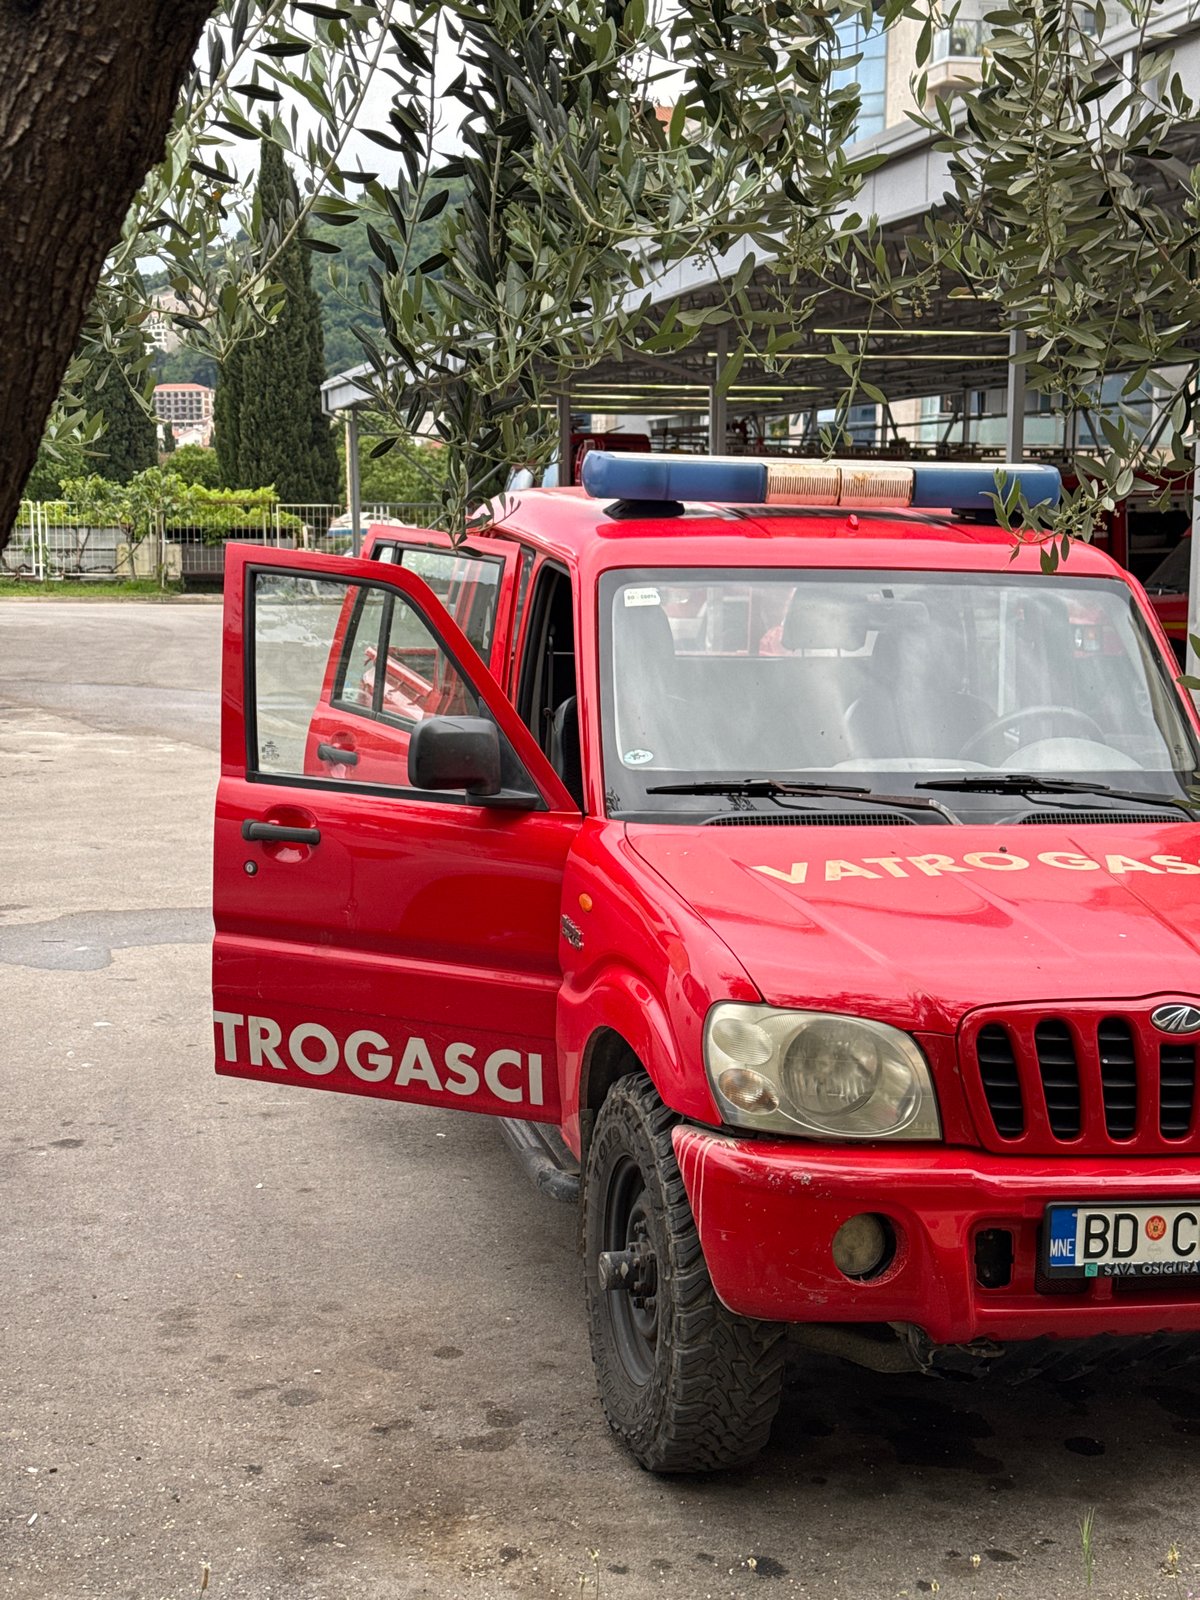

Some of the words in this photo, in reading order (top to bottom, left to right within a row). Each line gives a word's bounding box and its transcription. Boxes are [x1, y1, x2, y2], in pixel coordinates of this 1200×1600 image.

[751, 851, 1200, 885] VATROGAS
[213, 1010, 544, 1106] TROGASCI
[1050, 1238, 1075, 1257] MNE
[1083, 1213, 1139, 1259] BD
[1104, 1263, 1137, 1276] SAVA
